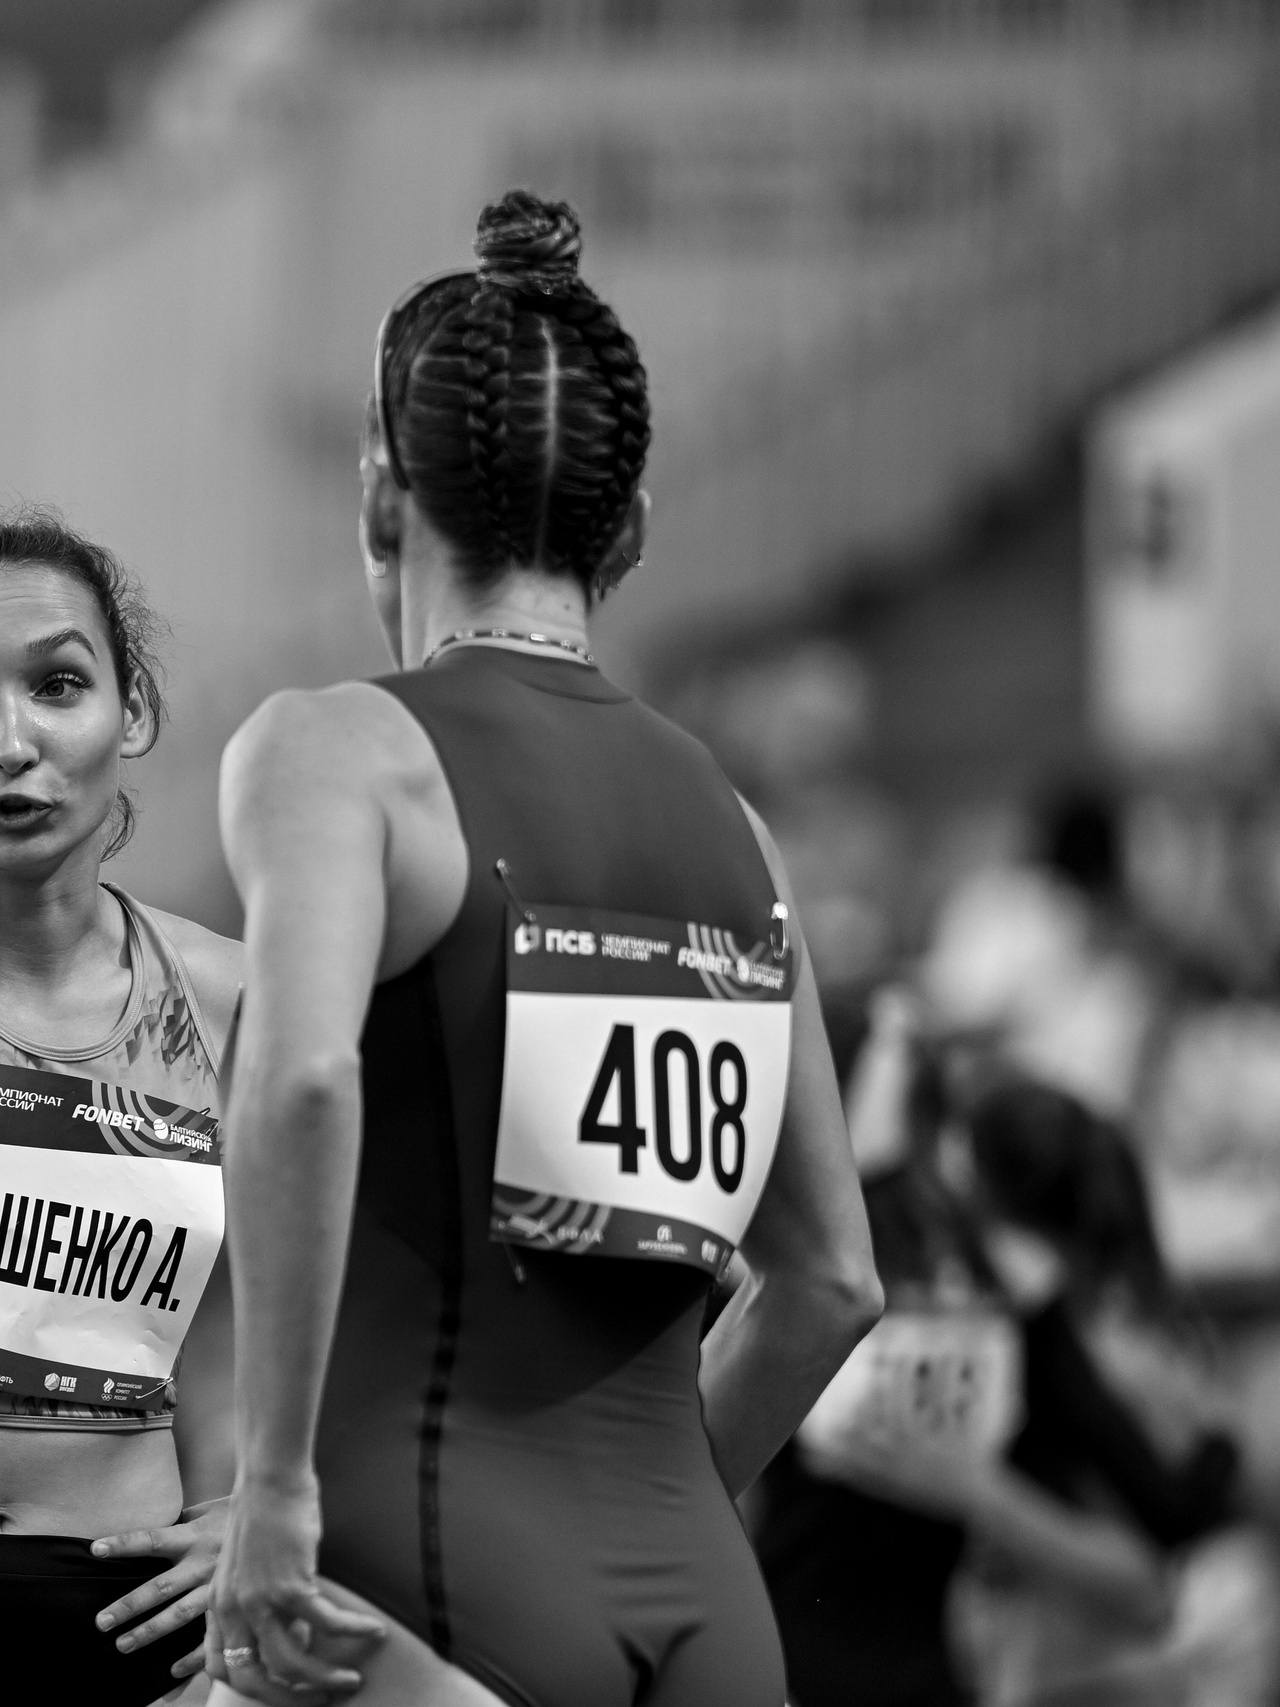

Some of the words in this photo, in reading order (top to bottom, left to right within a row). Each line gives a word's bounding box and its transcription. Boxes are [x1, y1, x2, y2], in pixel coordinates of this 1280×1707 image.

[545, 928, 597, 955] ПСБ
[601, 933, 671, 955] ЧЕМПИОНАТ
[677, 946, 731, 975] FONBET
[72, 1103, 145, 1132] FONBET
[578, 1023, 748, 1194] 408
[170, 1130, 213, 1152] ЛИЗИНГ
[140, 1226, 188, 1312] А.
[60, 1375, 77, 1388] НГК
